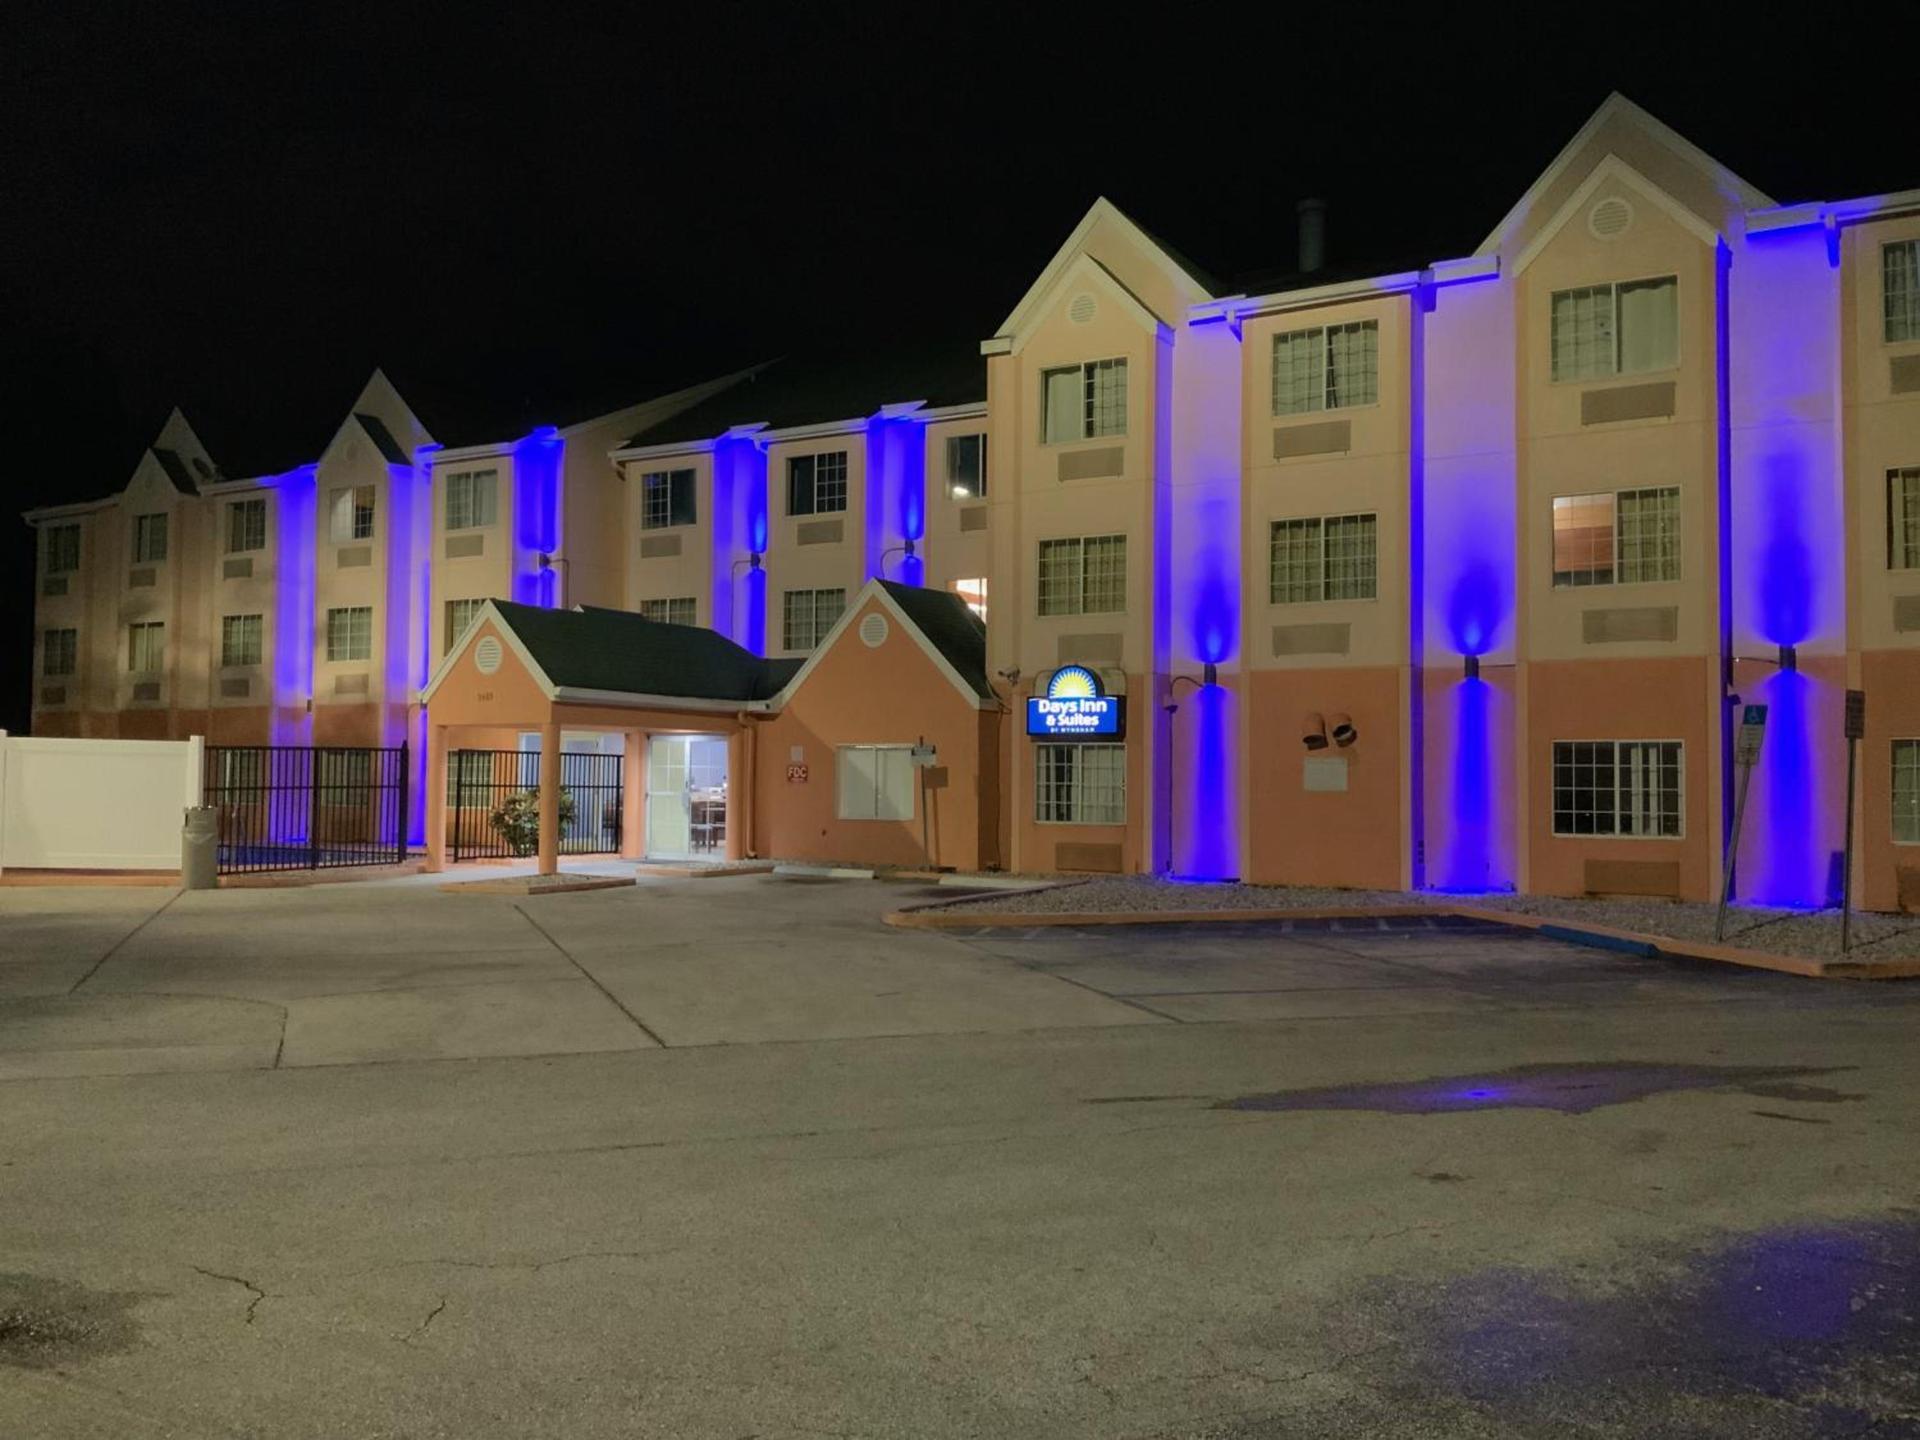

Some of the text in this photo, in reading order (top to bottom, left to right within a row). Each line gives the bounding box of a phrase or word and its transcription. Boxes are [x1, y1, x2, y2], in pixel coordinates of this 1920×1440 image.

[1038, 699, 1107, 715] Days Inn
[1046, 712, 1099, 726] & Suites
[788, 767, 807, 778] FDC
